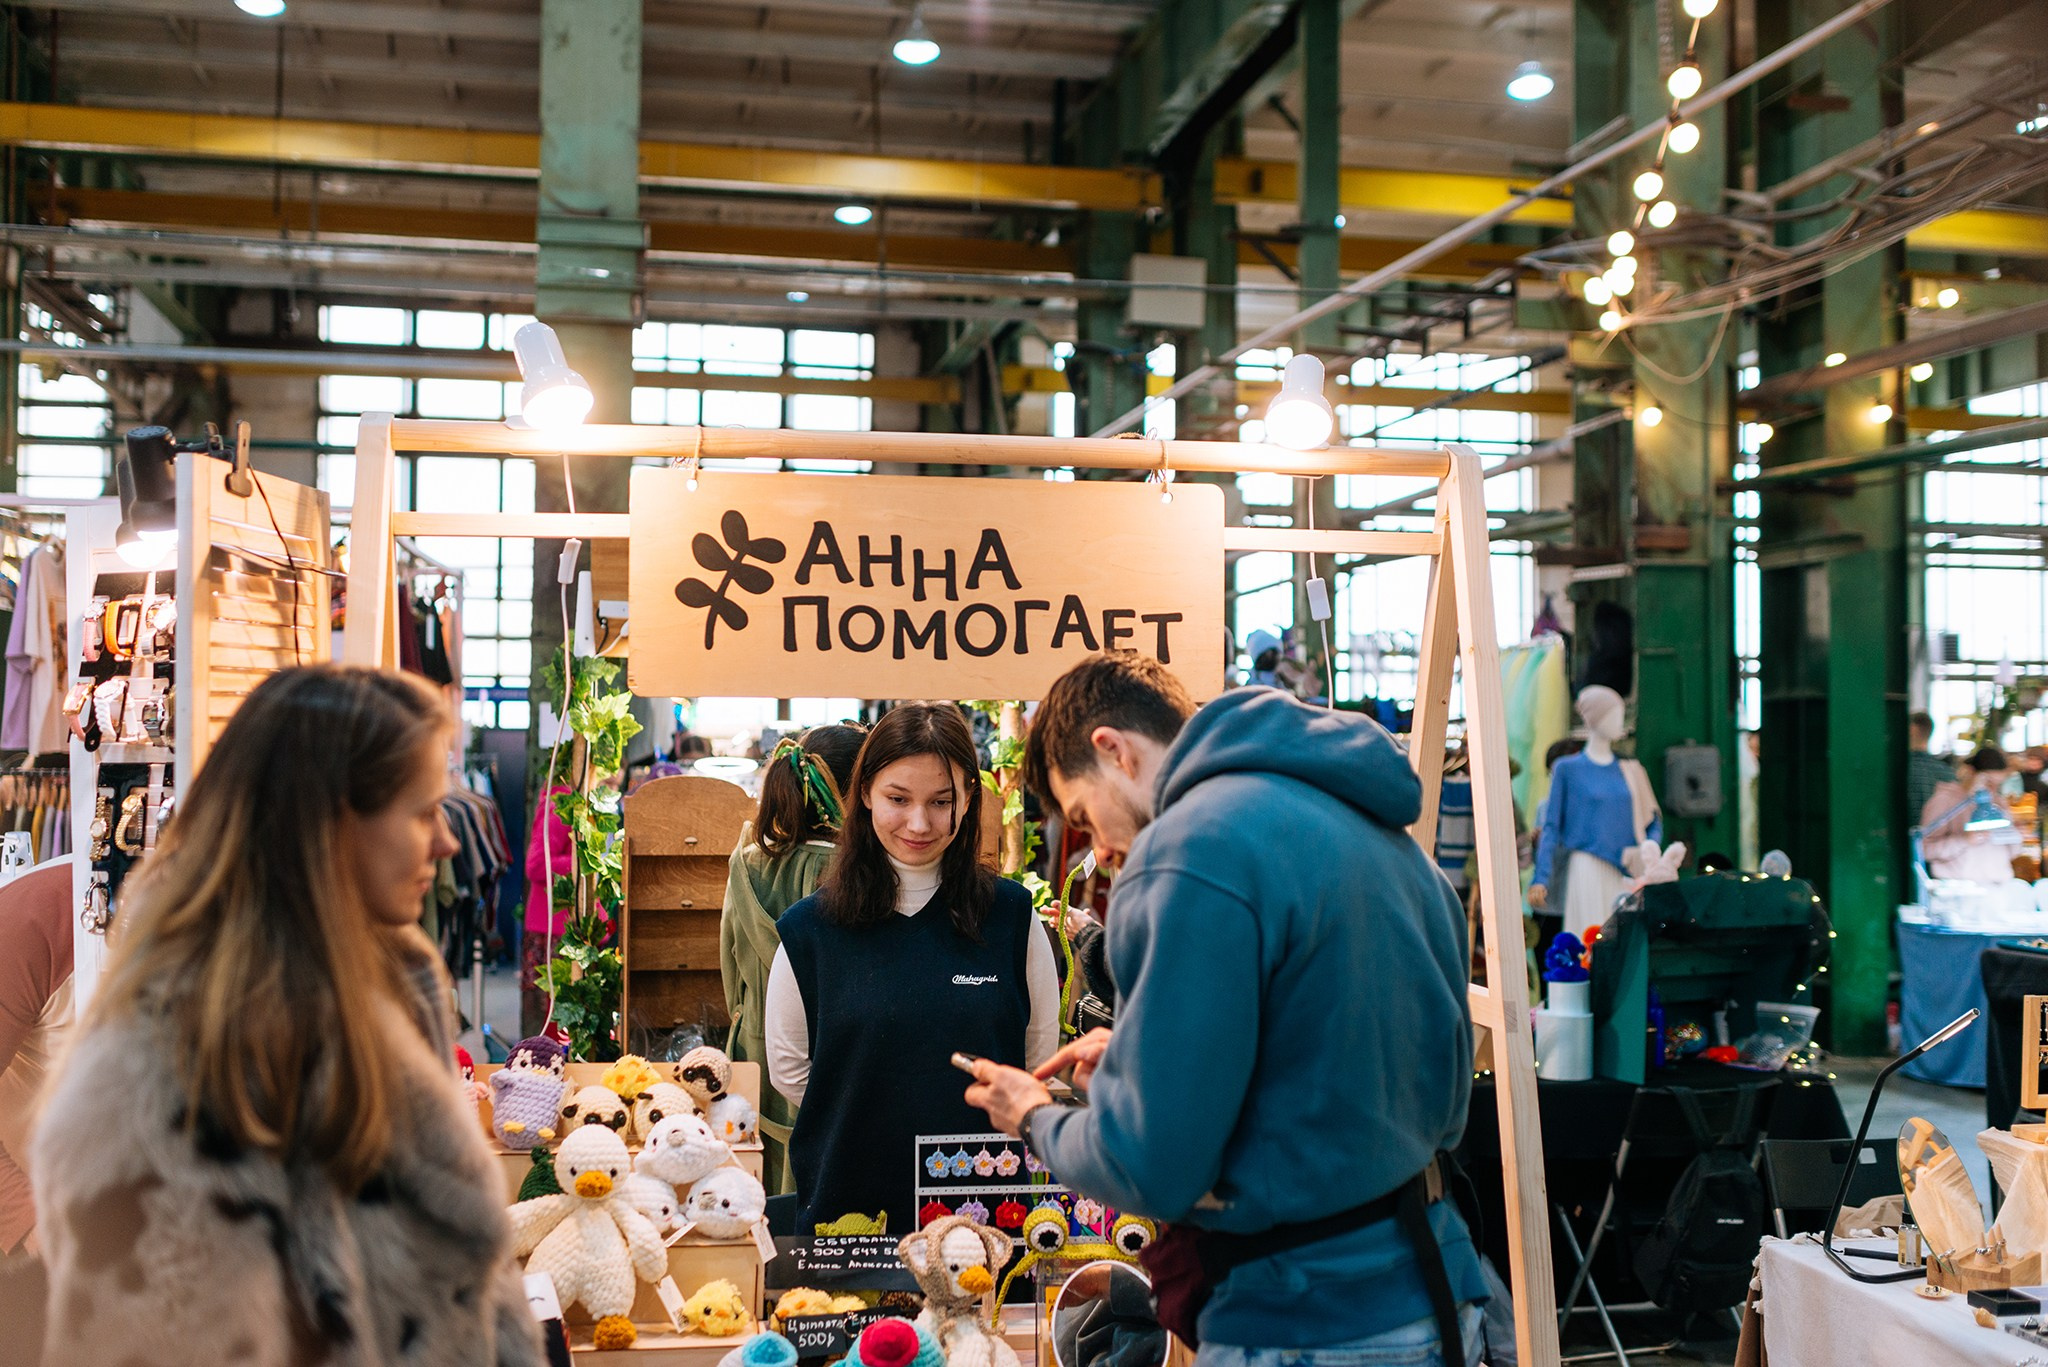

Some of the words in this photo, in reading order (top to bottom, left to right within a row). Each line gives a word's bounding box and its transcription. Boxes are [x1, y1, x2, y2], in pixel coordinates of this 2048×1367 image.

[795, 521, 1022, 601] АННА
[782, 594, 1183, 664] ПОМОГАЕТ
[789, 1247, 808, 1257] +7
[812, 1247, 845, 1257] 900
